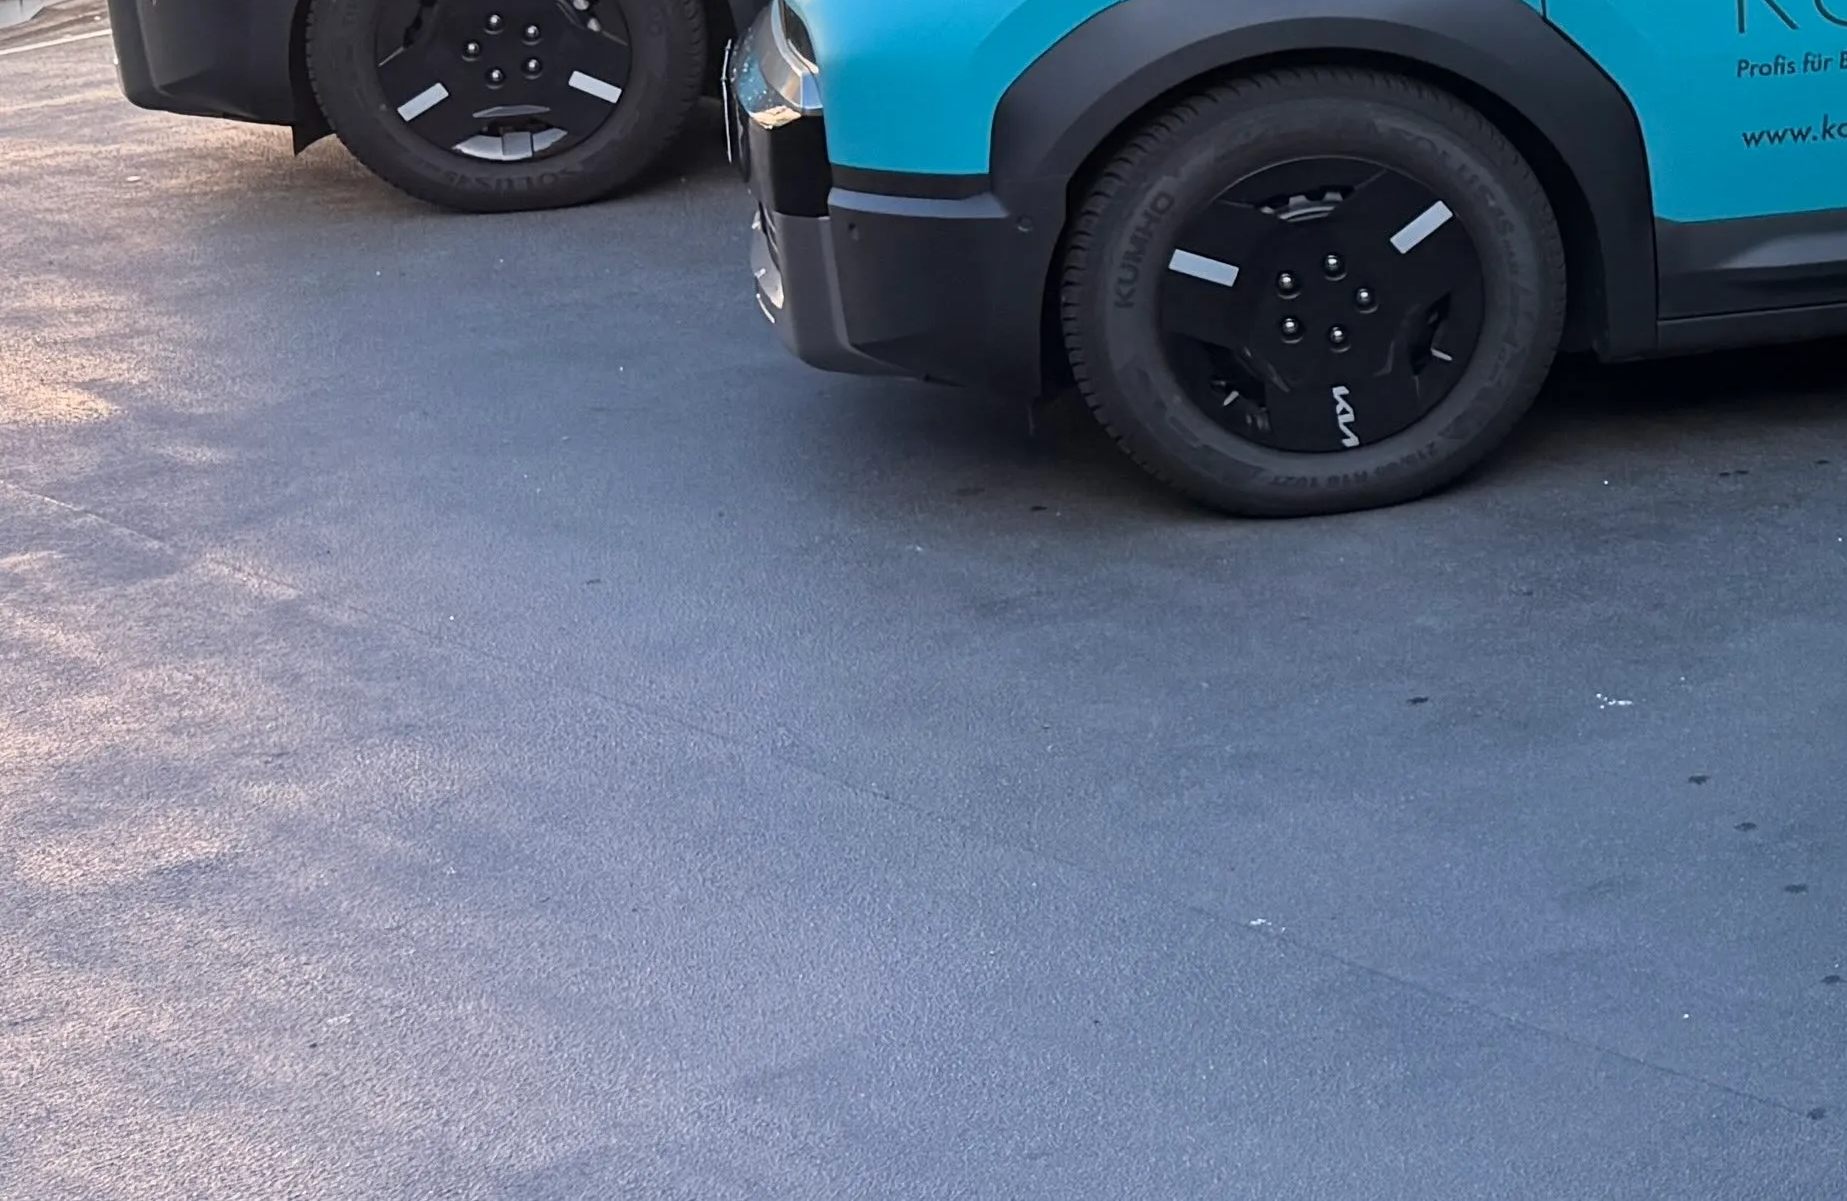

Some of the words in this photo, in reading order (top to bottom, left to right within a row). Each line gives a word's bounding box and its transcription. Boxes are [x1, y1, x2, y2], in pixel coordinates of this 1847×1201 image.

[1736, 54, 1796, 78] Profis
[1802, 51, 1833, 74] für
[1114, 189, 1176, 310] KUMHO
